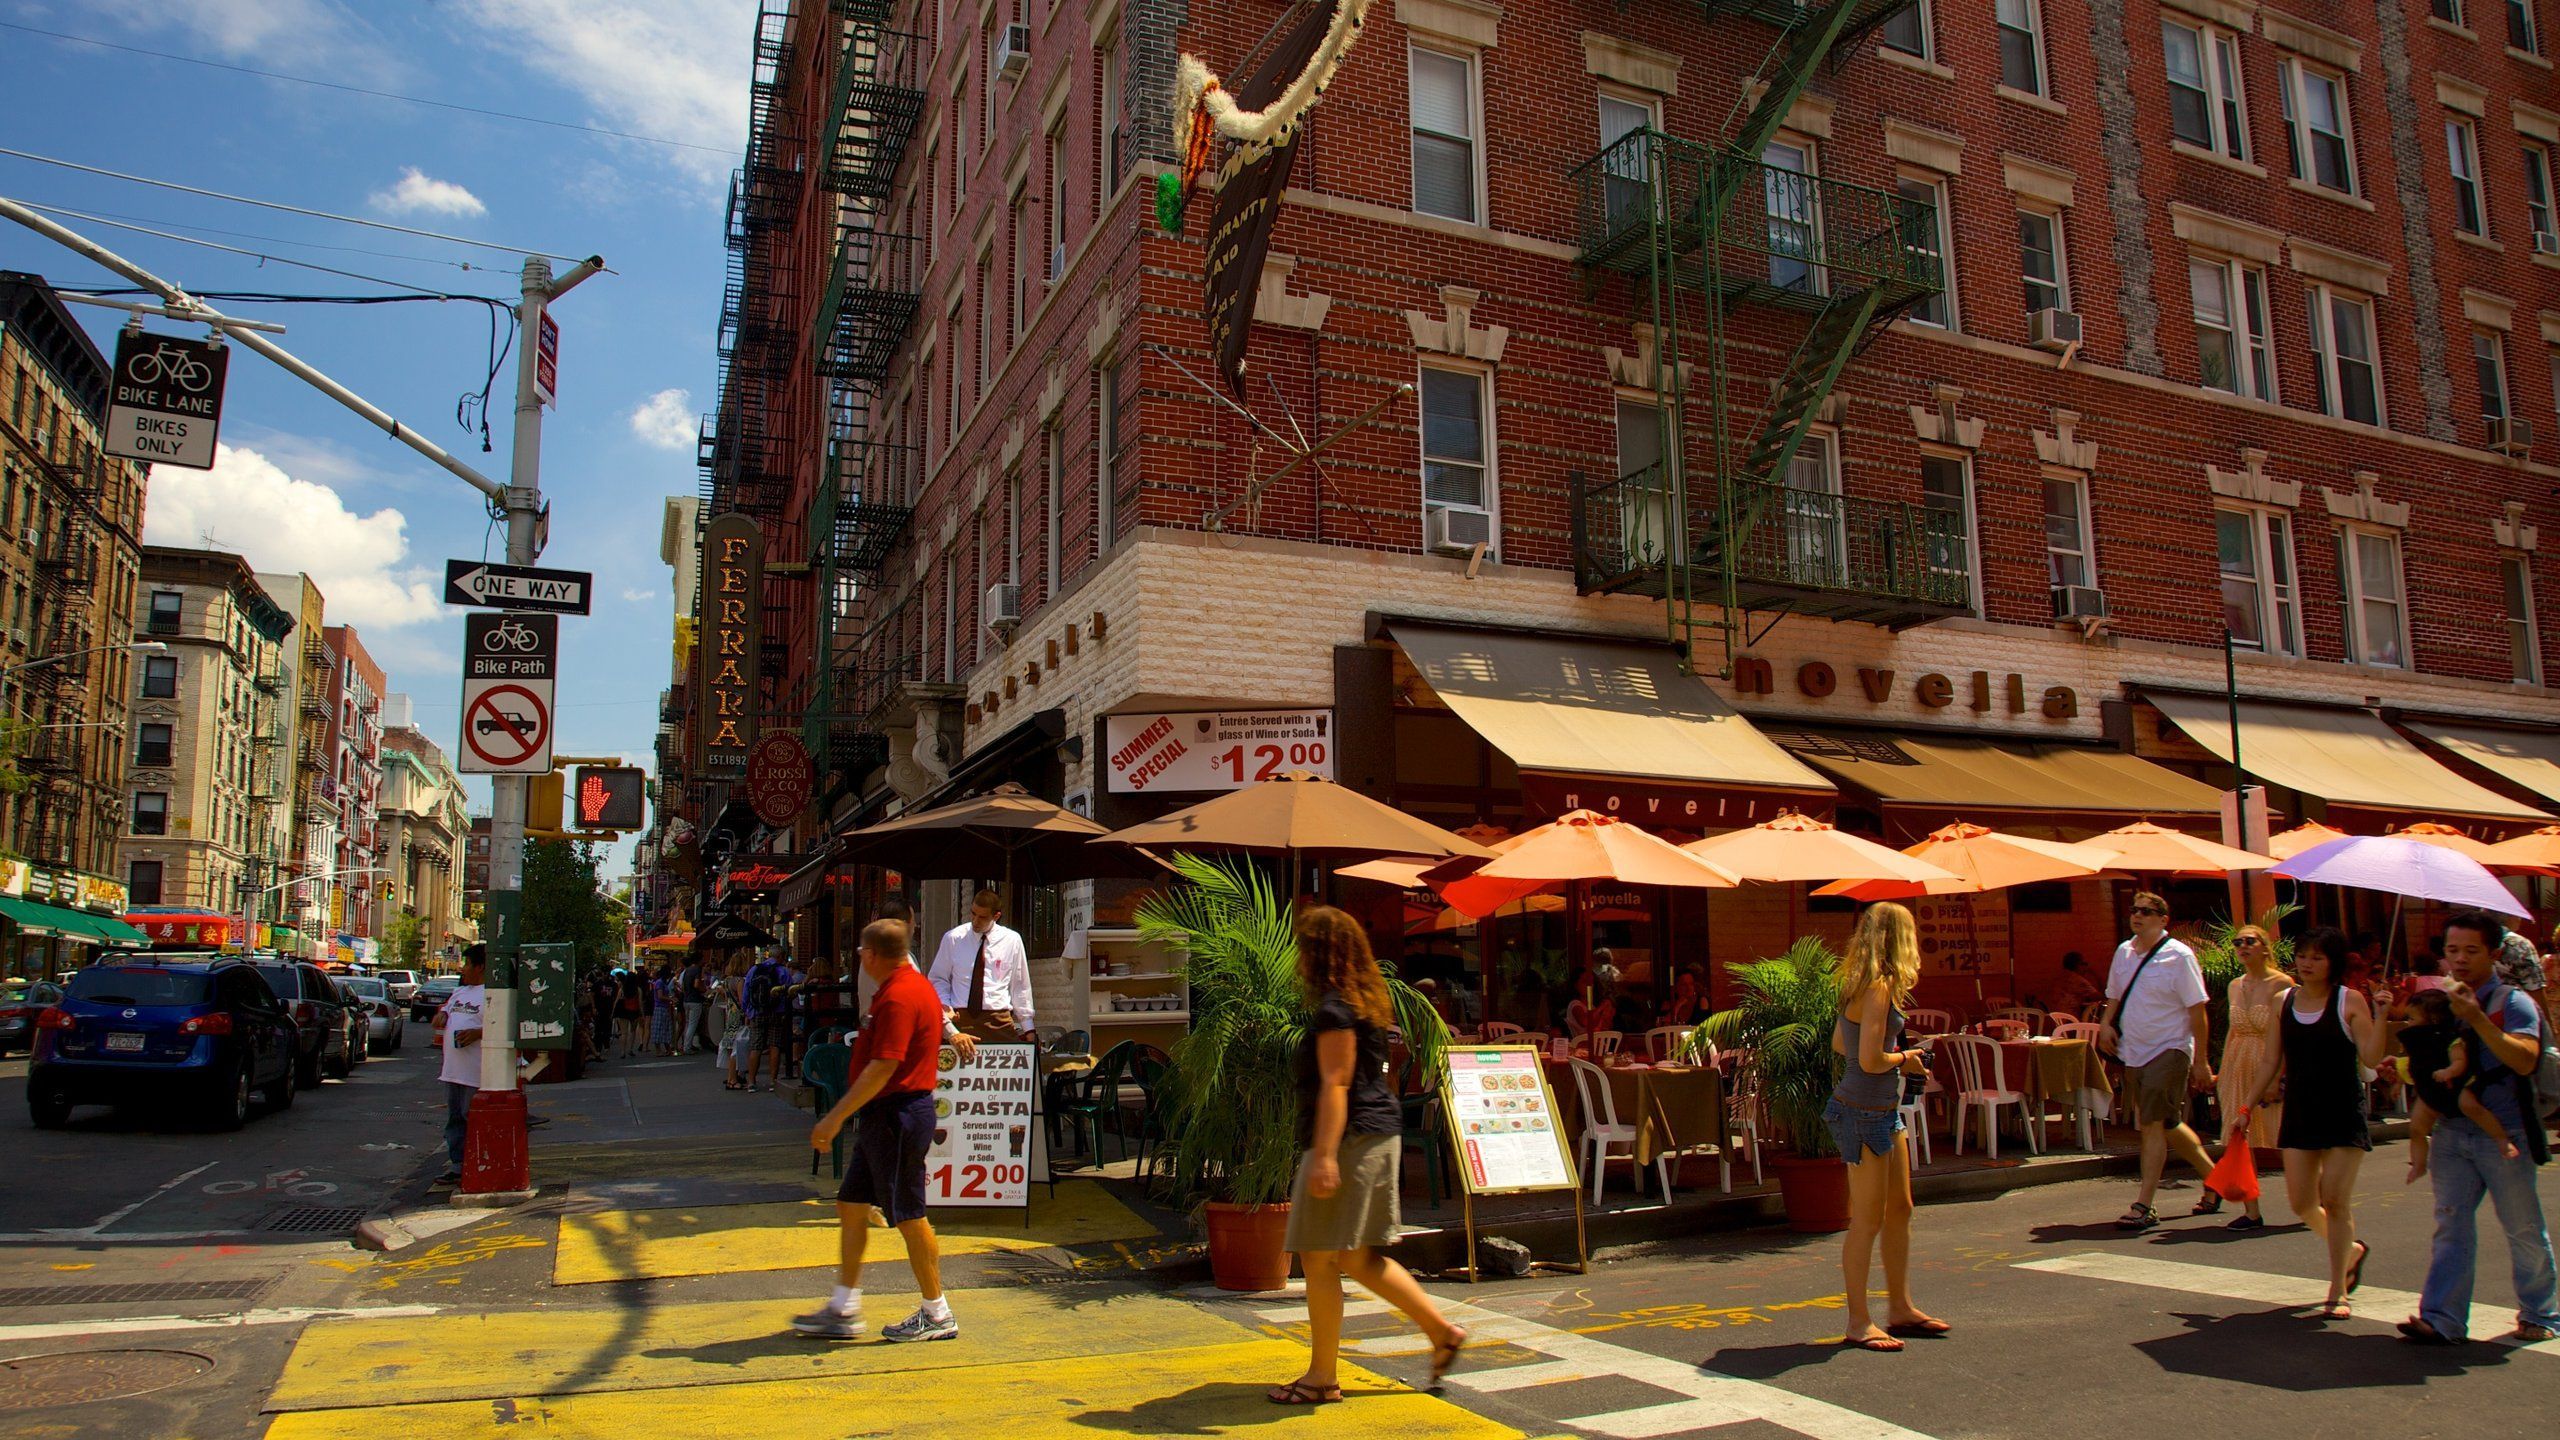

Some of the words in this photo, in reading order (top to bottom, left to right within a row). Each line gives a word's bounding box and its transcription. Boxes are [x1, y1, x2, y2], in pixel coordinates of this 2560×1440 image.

[118, 386, 159, 405] BIKE
[165, 393, 213, 414] LANE
[136, 417, 188, 437] BIKES
[136, 437, 183, 455] ONLY
[473, 576, 516, 595] ONE
[528, 581, 571, 600] WAY
[708, 537, 750, 747] FERRARA
[474, 660, 507, 674] Bike
[511, 660, 545, 674] Path
[1735, 657, 2077, 719] novella
[1219, 715, 1249, 726] Entrée
[1250, 715, 1282, 725] Served
[1283, 715, 1303, 725] with
[1111, 715, 1175, 772] SUMMER
[1218, 730, 1243, 741] glass
[1245, 729, 1254, 738] of
[1255, 729, 1279, 738] Wine
[1281, 730, 1291, 738] or
[1292, 728, 1315, 738] Soda
[1128, 738, 1188, 790] SPECIAL
[1566, 794, 1788, 819] novella
[2385, 823, 2506, 841] nlla
[1590, 892, 1641, 905] novella
[959, 1055, 1029, 1069] PIZZA
[958, 1077, 1031, 1091] PANINI
[955, 1101, 1029, 1116] PASTA
[962, 1121, 987, 1130] Served
[988, 1121, 1004, 1130] with
[972, 1132, 992, 1141] glass
[993, 1132, 1001, 1140] of
[973, 1143, 992, 1151] Wine
[1468, 1140, 1478, 1161] MENU
[977, 1154, 995, 1162] Soda
[1473, 1161, 1485, 1186] LUNCH
